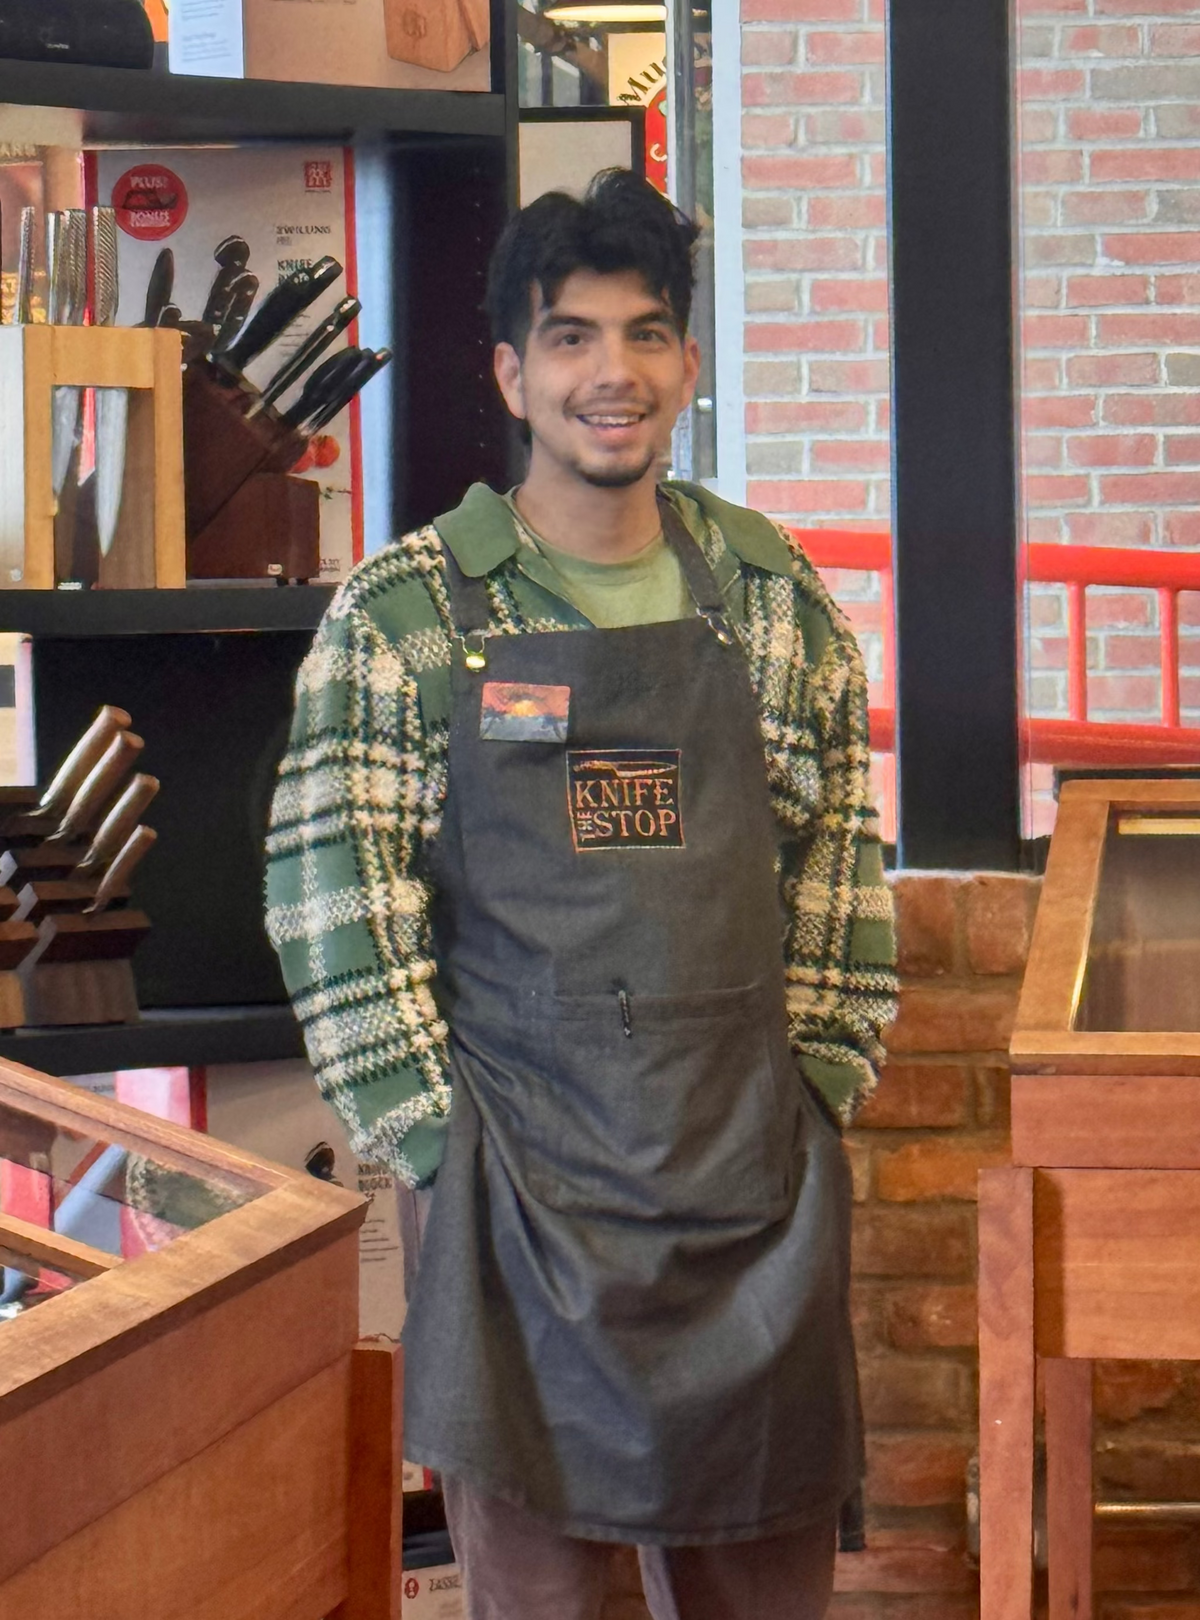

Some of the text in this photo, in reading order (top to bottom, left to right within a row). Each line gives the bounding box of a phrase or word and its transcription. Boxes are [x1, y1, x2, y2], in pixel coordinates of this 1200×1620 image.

[574, 778, 675, 808] KNIFE
[577, 811, 596, 842] THE
[593, 809, 677, 837] STOP
